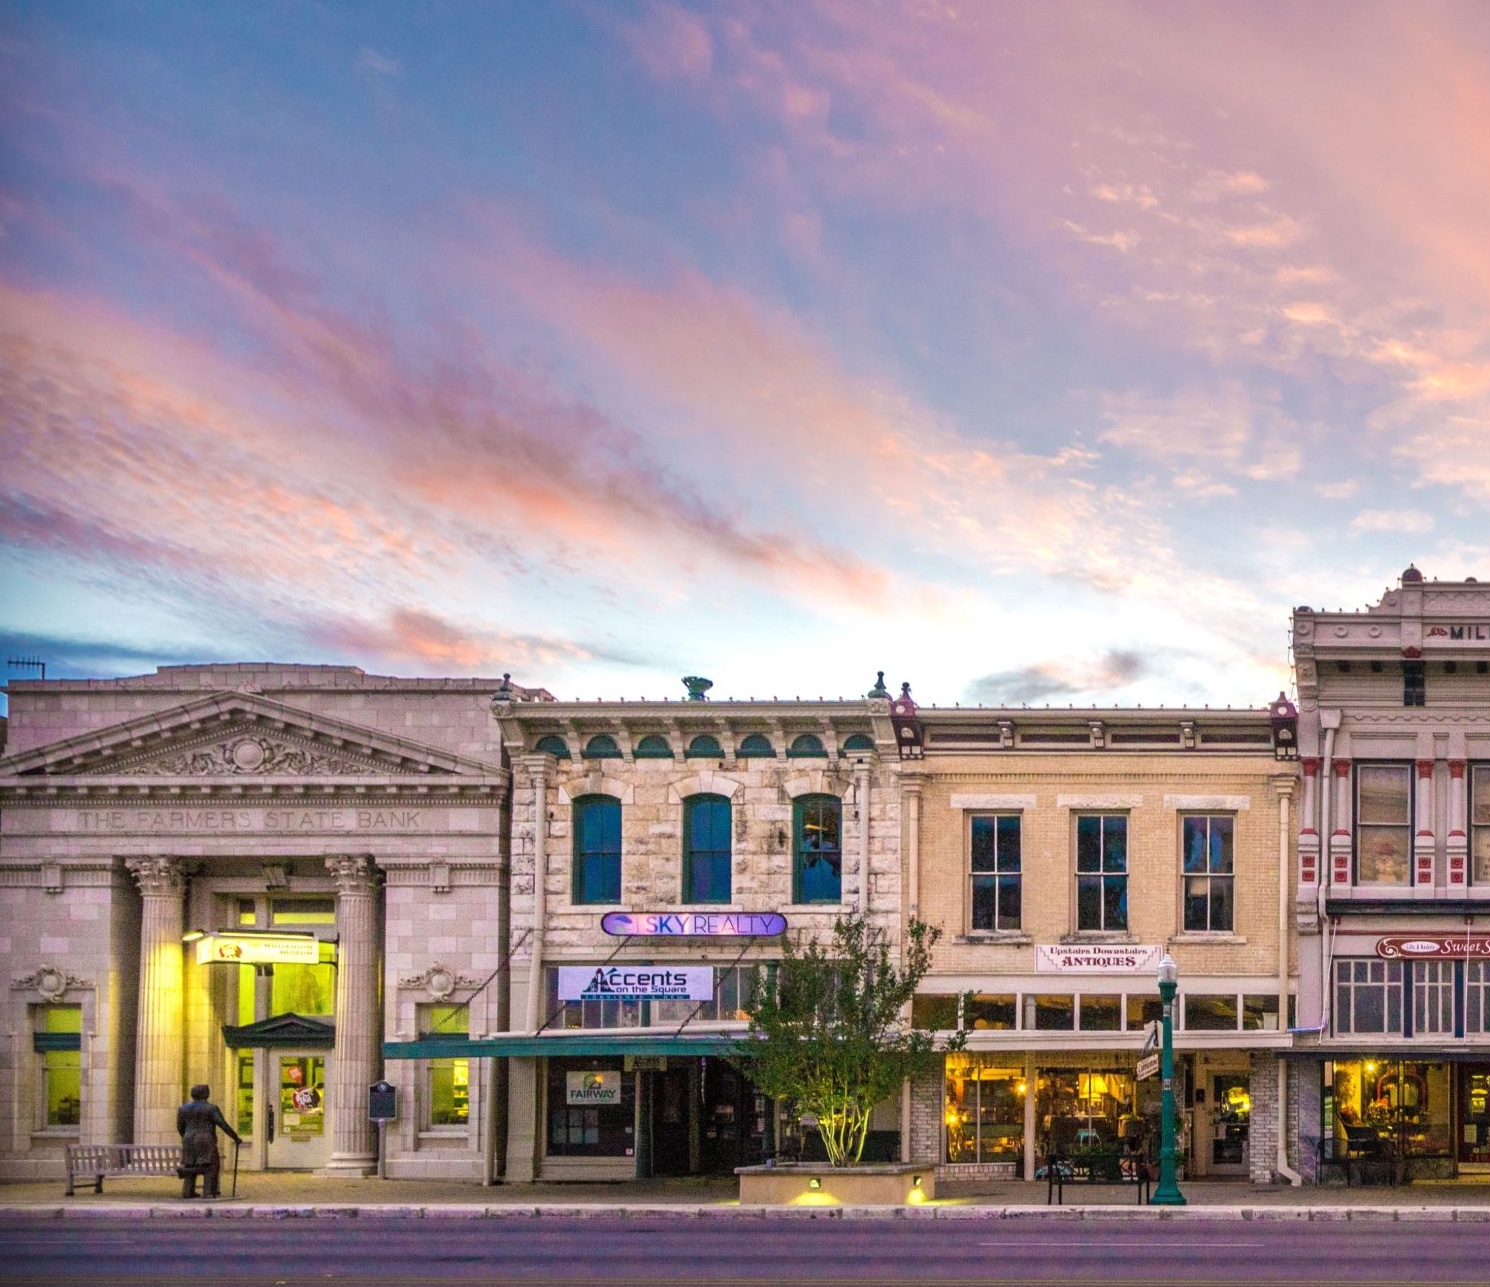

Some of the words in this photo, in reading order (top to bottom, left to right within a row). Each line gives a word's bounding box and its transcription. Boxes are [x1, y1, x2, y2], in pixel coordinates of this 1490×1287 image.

[78, 811, 125, 829] THE
[136, 811, 252, 829] FARMERS
[265, 811, 344, 828] STATE
[357, 811, 420, 828] BANK
[646, 915, 690, 934] SKY
[694, 915, 775, 934] REALTY
[1050, 947, 1091, 955] Upstairs
[1093, 947, 1147, 955] Downstairs
[1440, 939, 1480, 954] Sweet
[1062, 956, 1136, 967] ANTIQUES
[583, 967, 687, 993] Accents
[631, 985, 648, 993] the
[651, 985, 687, 995] Square
[571, 1089, 616, 1099] FAIRWAY
